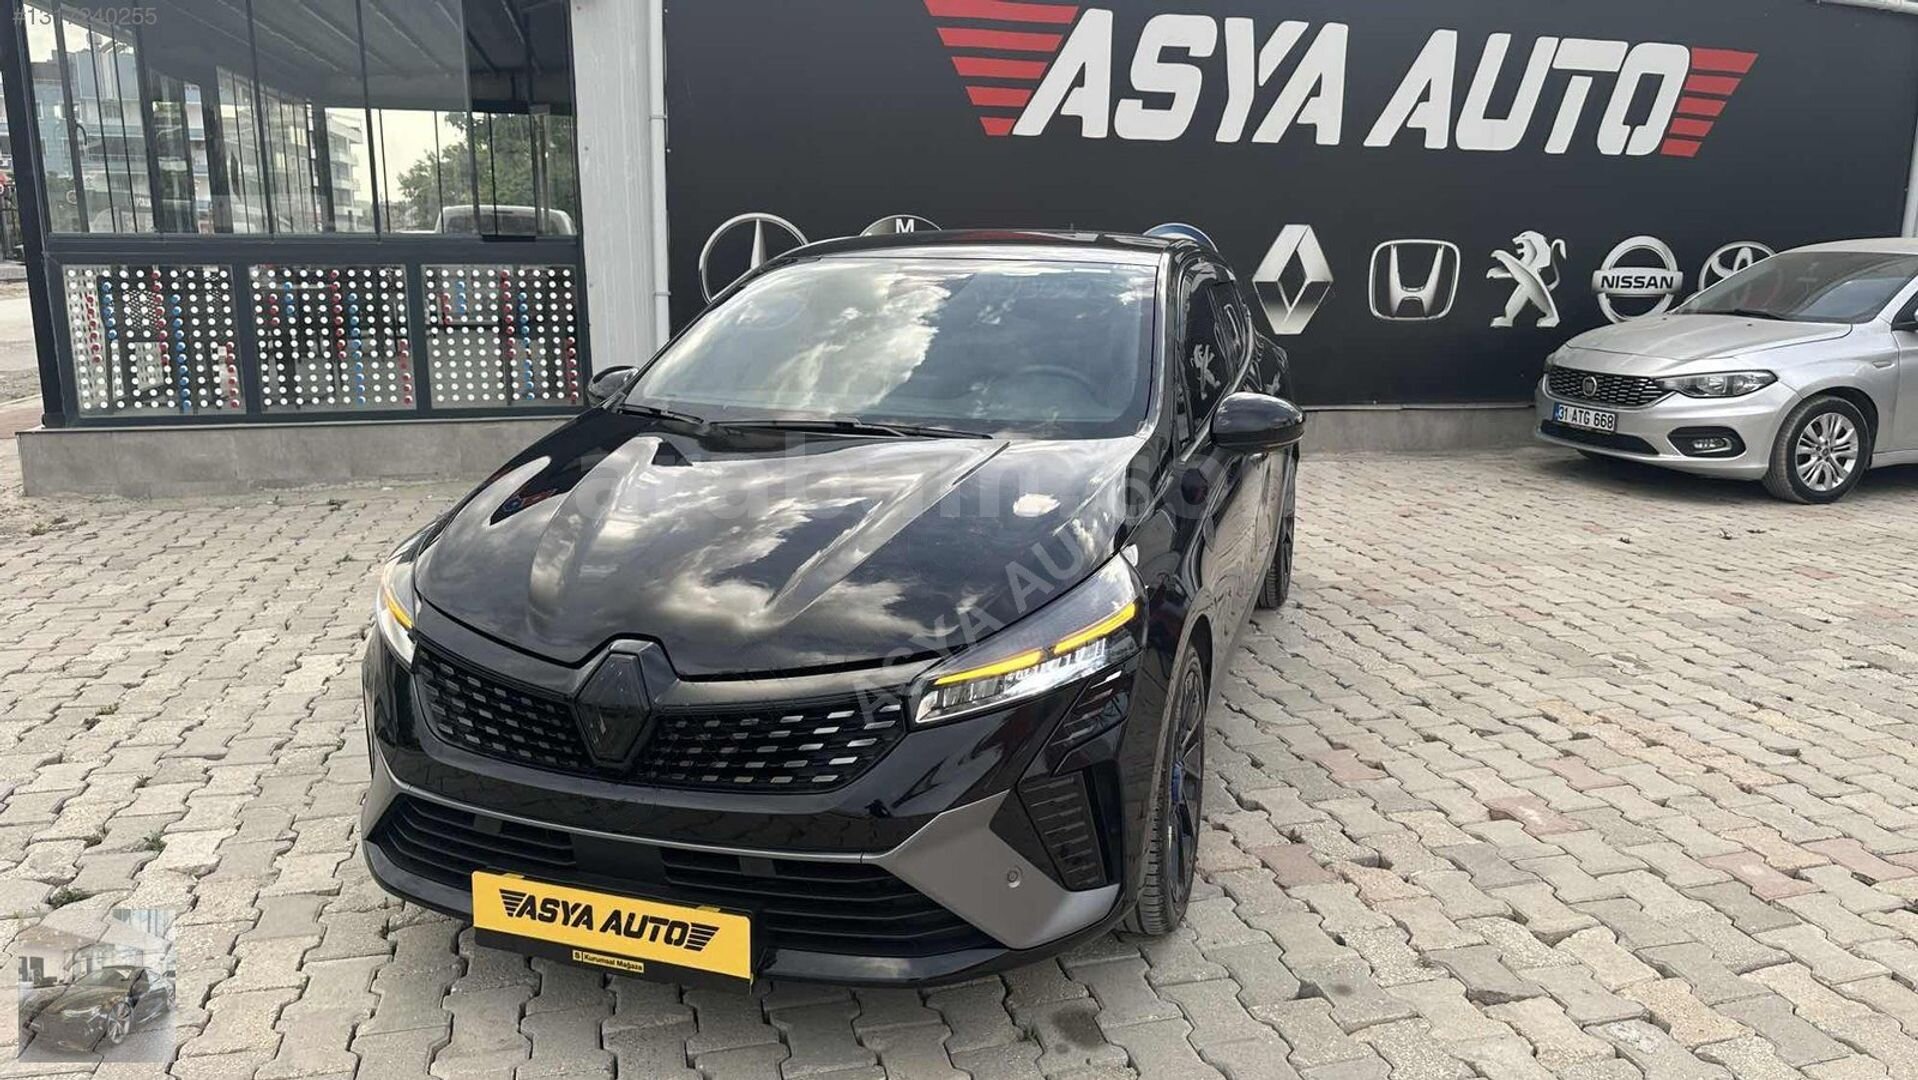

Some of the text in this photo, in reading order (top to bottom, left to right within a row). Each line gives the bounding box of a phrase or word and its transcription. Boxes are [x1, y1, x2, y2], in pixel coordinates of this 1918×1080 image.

[1012, 8, 1690, 156] ASYA AUTO
[895, 218, 915, 233] M
[1601, 275, 1674, 289] NISSAN
[1559, 406, 1614, 429] 31 ATG 668
[515, 894, 691, 947] ASYA AUTO
[584, 954, 616, 966] Kurumsal
